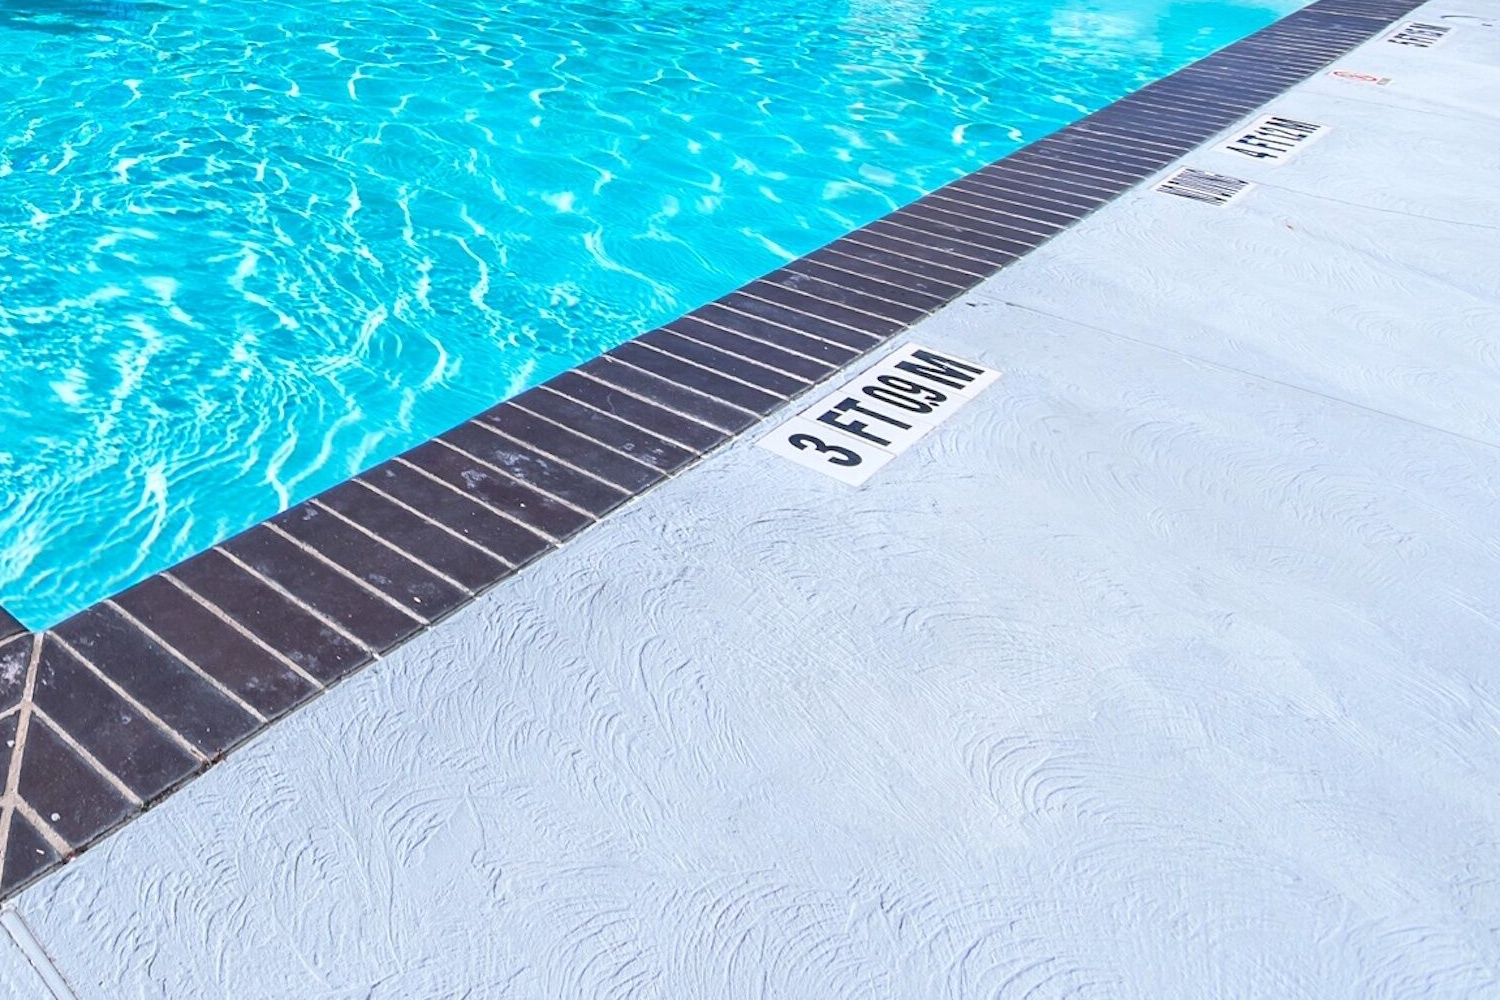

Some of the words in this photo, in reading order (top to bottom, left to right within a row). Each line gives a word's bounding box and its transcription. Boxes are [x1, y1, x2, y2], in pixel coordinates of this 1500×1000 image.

[1265, 117, 1321, 133] M
[1226, 146, 1279, 159] 4
[1236, 134, 1296, 153] FT
[894, 349, 985, 390] M
[862, 375, 947, 414] 0.9
[816, 397, 913, 447] FT
[788, 433, 863, 467] 3
